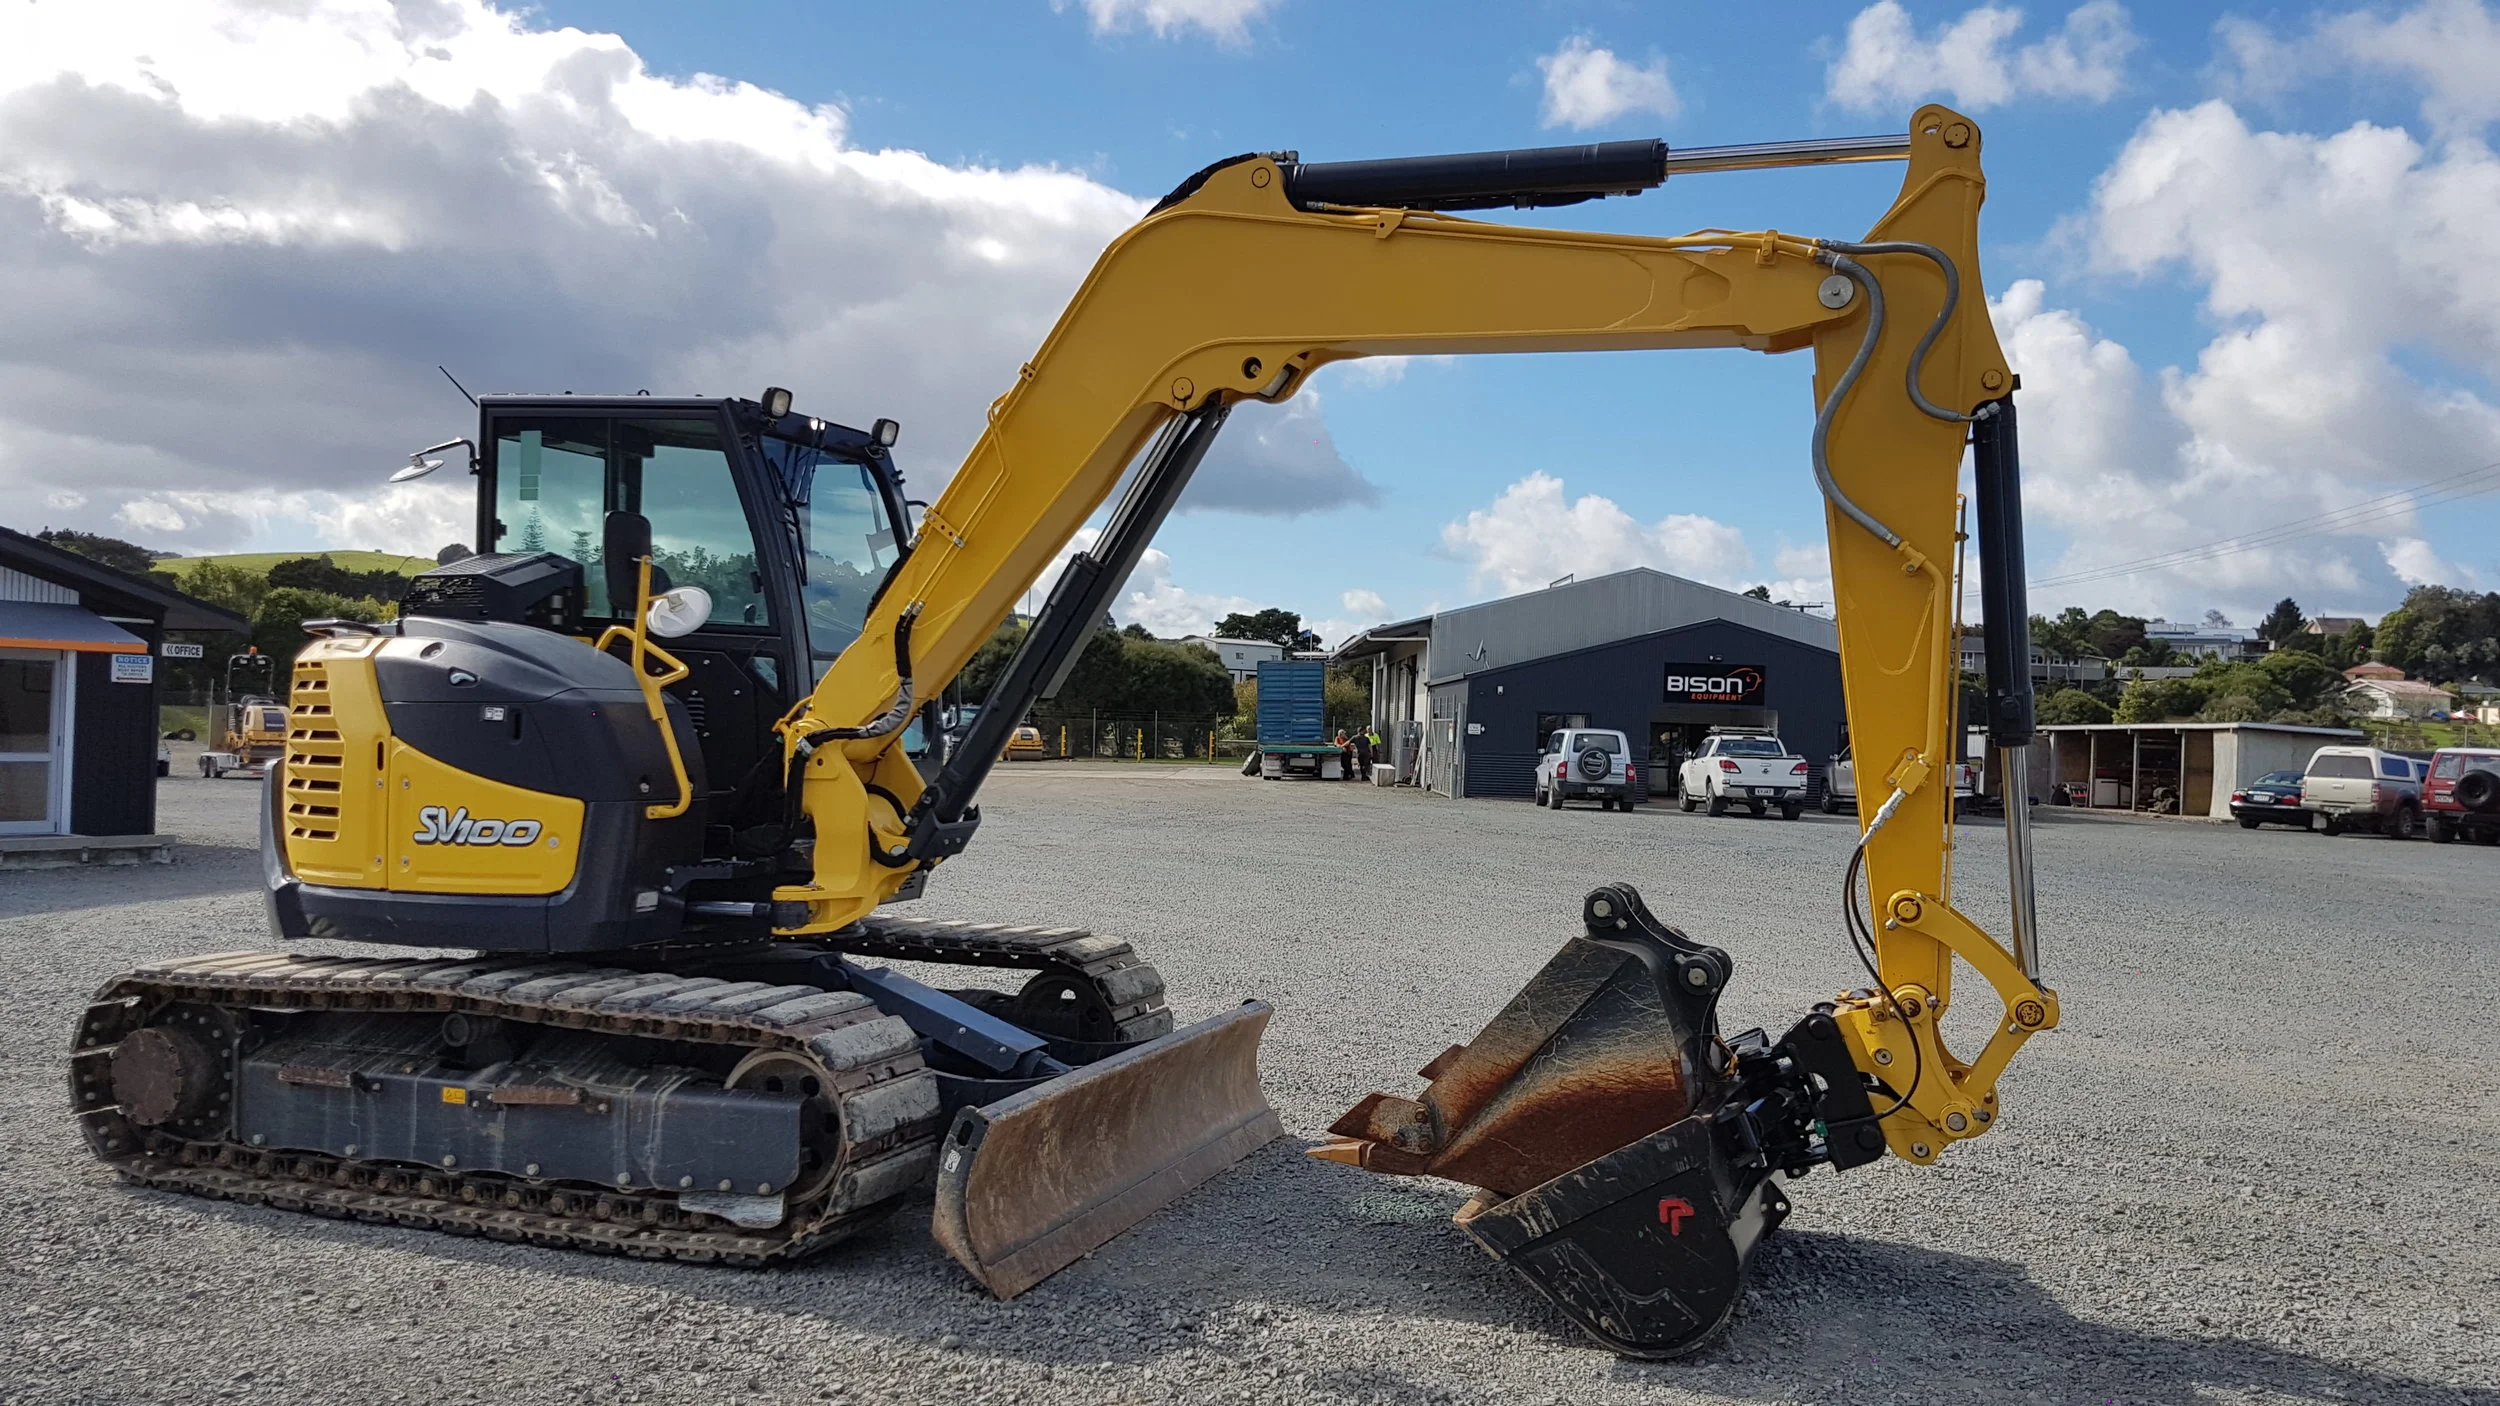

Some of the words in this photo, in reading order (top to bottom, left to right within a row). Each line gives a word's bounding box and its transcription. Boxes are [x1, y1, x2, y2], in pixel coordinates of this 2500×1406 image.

[174, 645, 201, 656] OFFICE
[117, 656, 148, 664] NOTICE
[1667, 675, 1743, 694] BISON
[1691, 692, 1742, 701] EQUIPMENT
[413, 806, 542, 846] SV100
